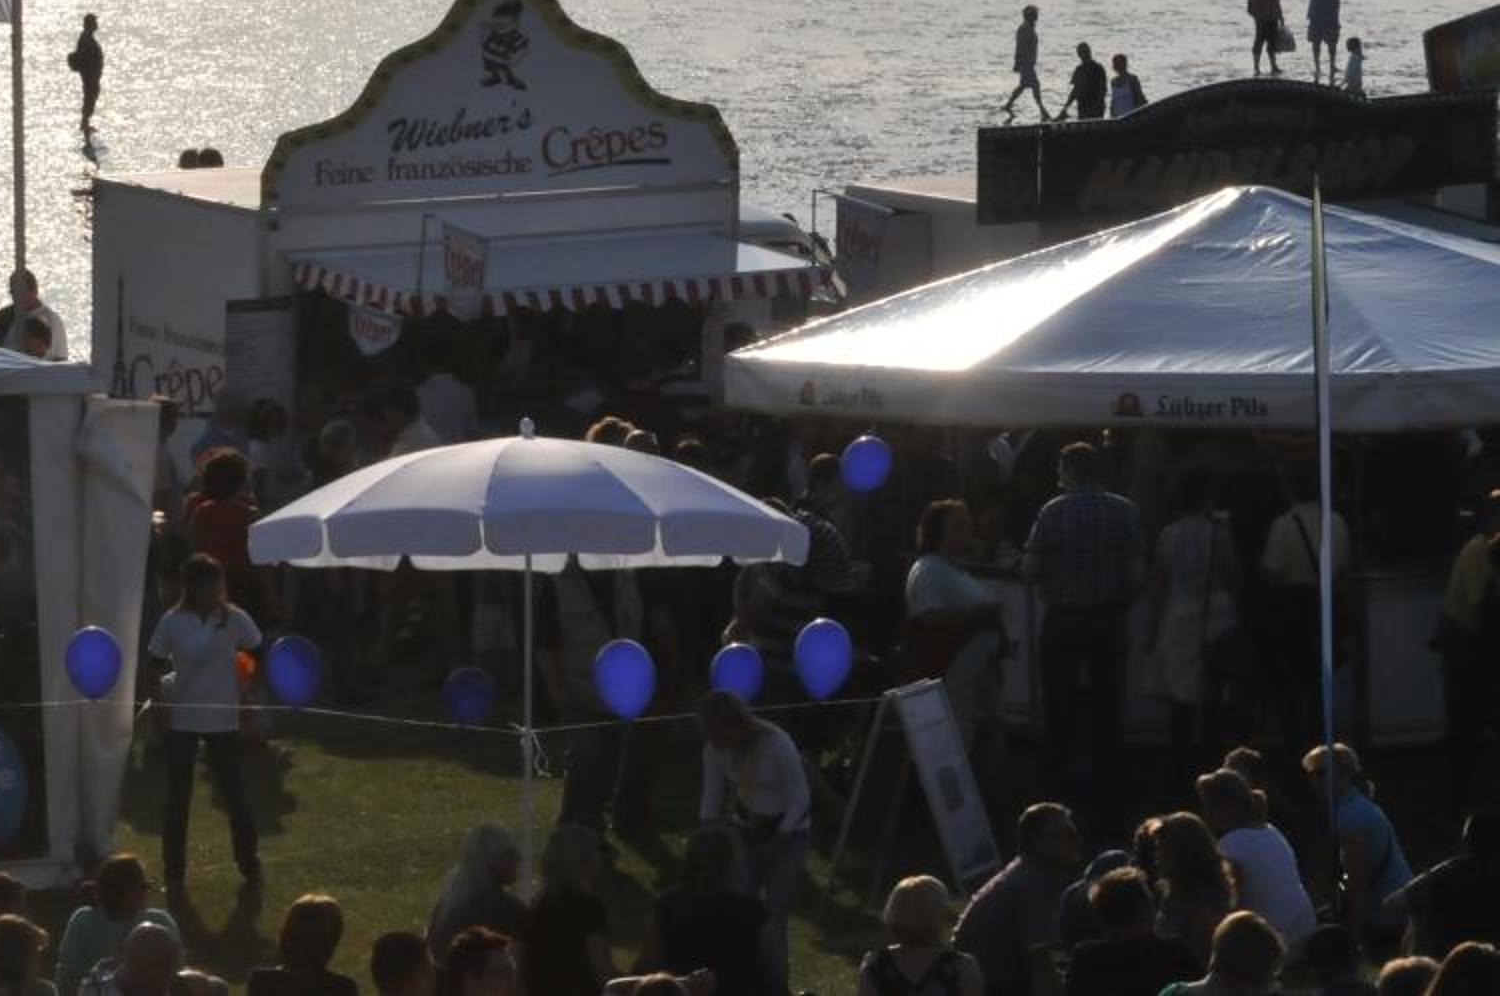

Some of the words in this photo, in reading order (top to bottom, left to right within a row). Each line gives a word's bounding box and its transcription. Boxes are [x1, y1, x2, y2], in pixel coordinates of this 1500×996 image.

[315, 161, 373, 186] Feine
[387, 151, 532, 181] französische
[542, 121, 668, 169] Crêpes
[387, 100, 533, 153] Wiebner's
[130, 354, 223, 418] Crêpe
